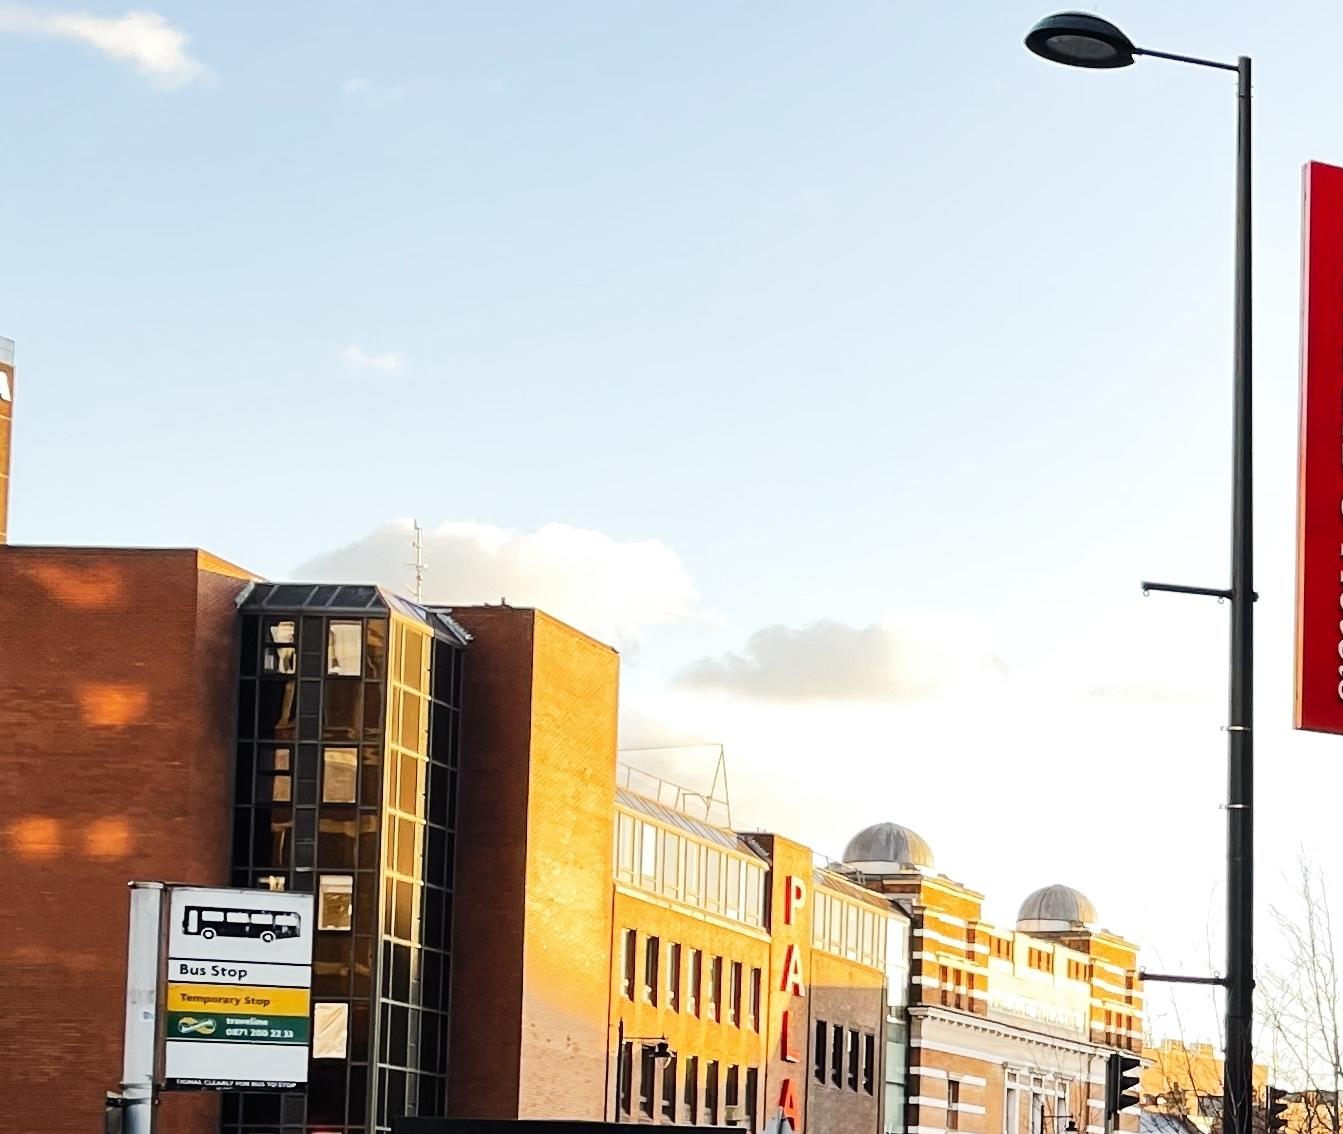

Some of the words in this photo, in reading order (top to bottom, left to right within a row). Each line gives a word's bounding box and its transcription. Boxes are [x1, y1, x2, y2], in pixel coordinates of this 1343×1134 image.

[180, 964, 206, 975] Bus
[211, 965, 247, 980] Stop
[180, 993, 240, 1005] Temporary
[244, 996, 270, 1007] Stop
